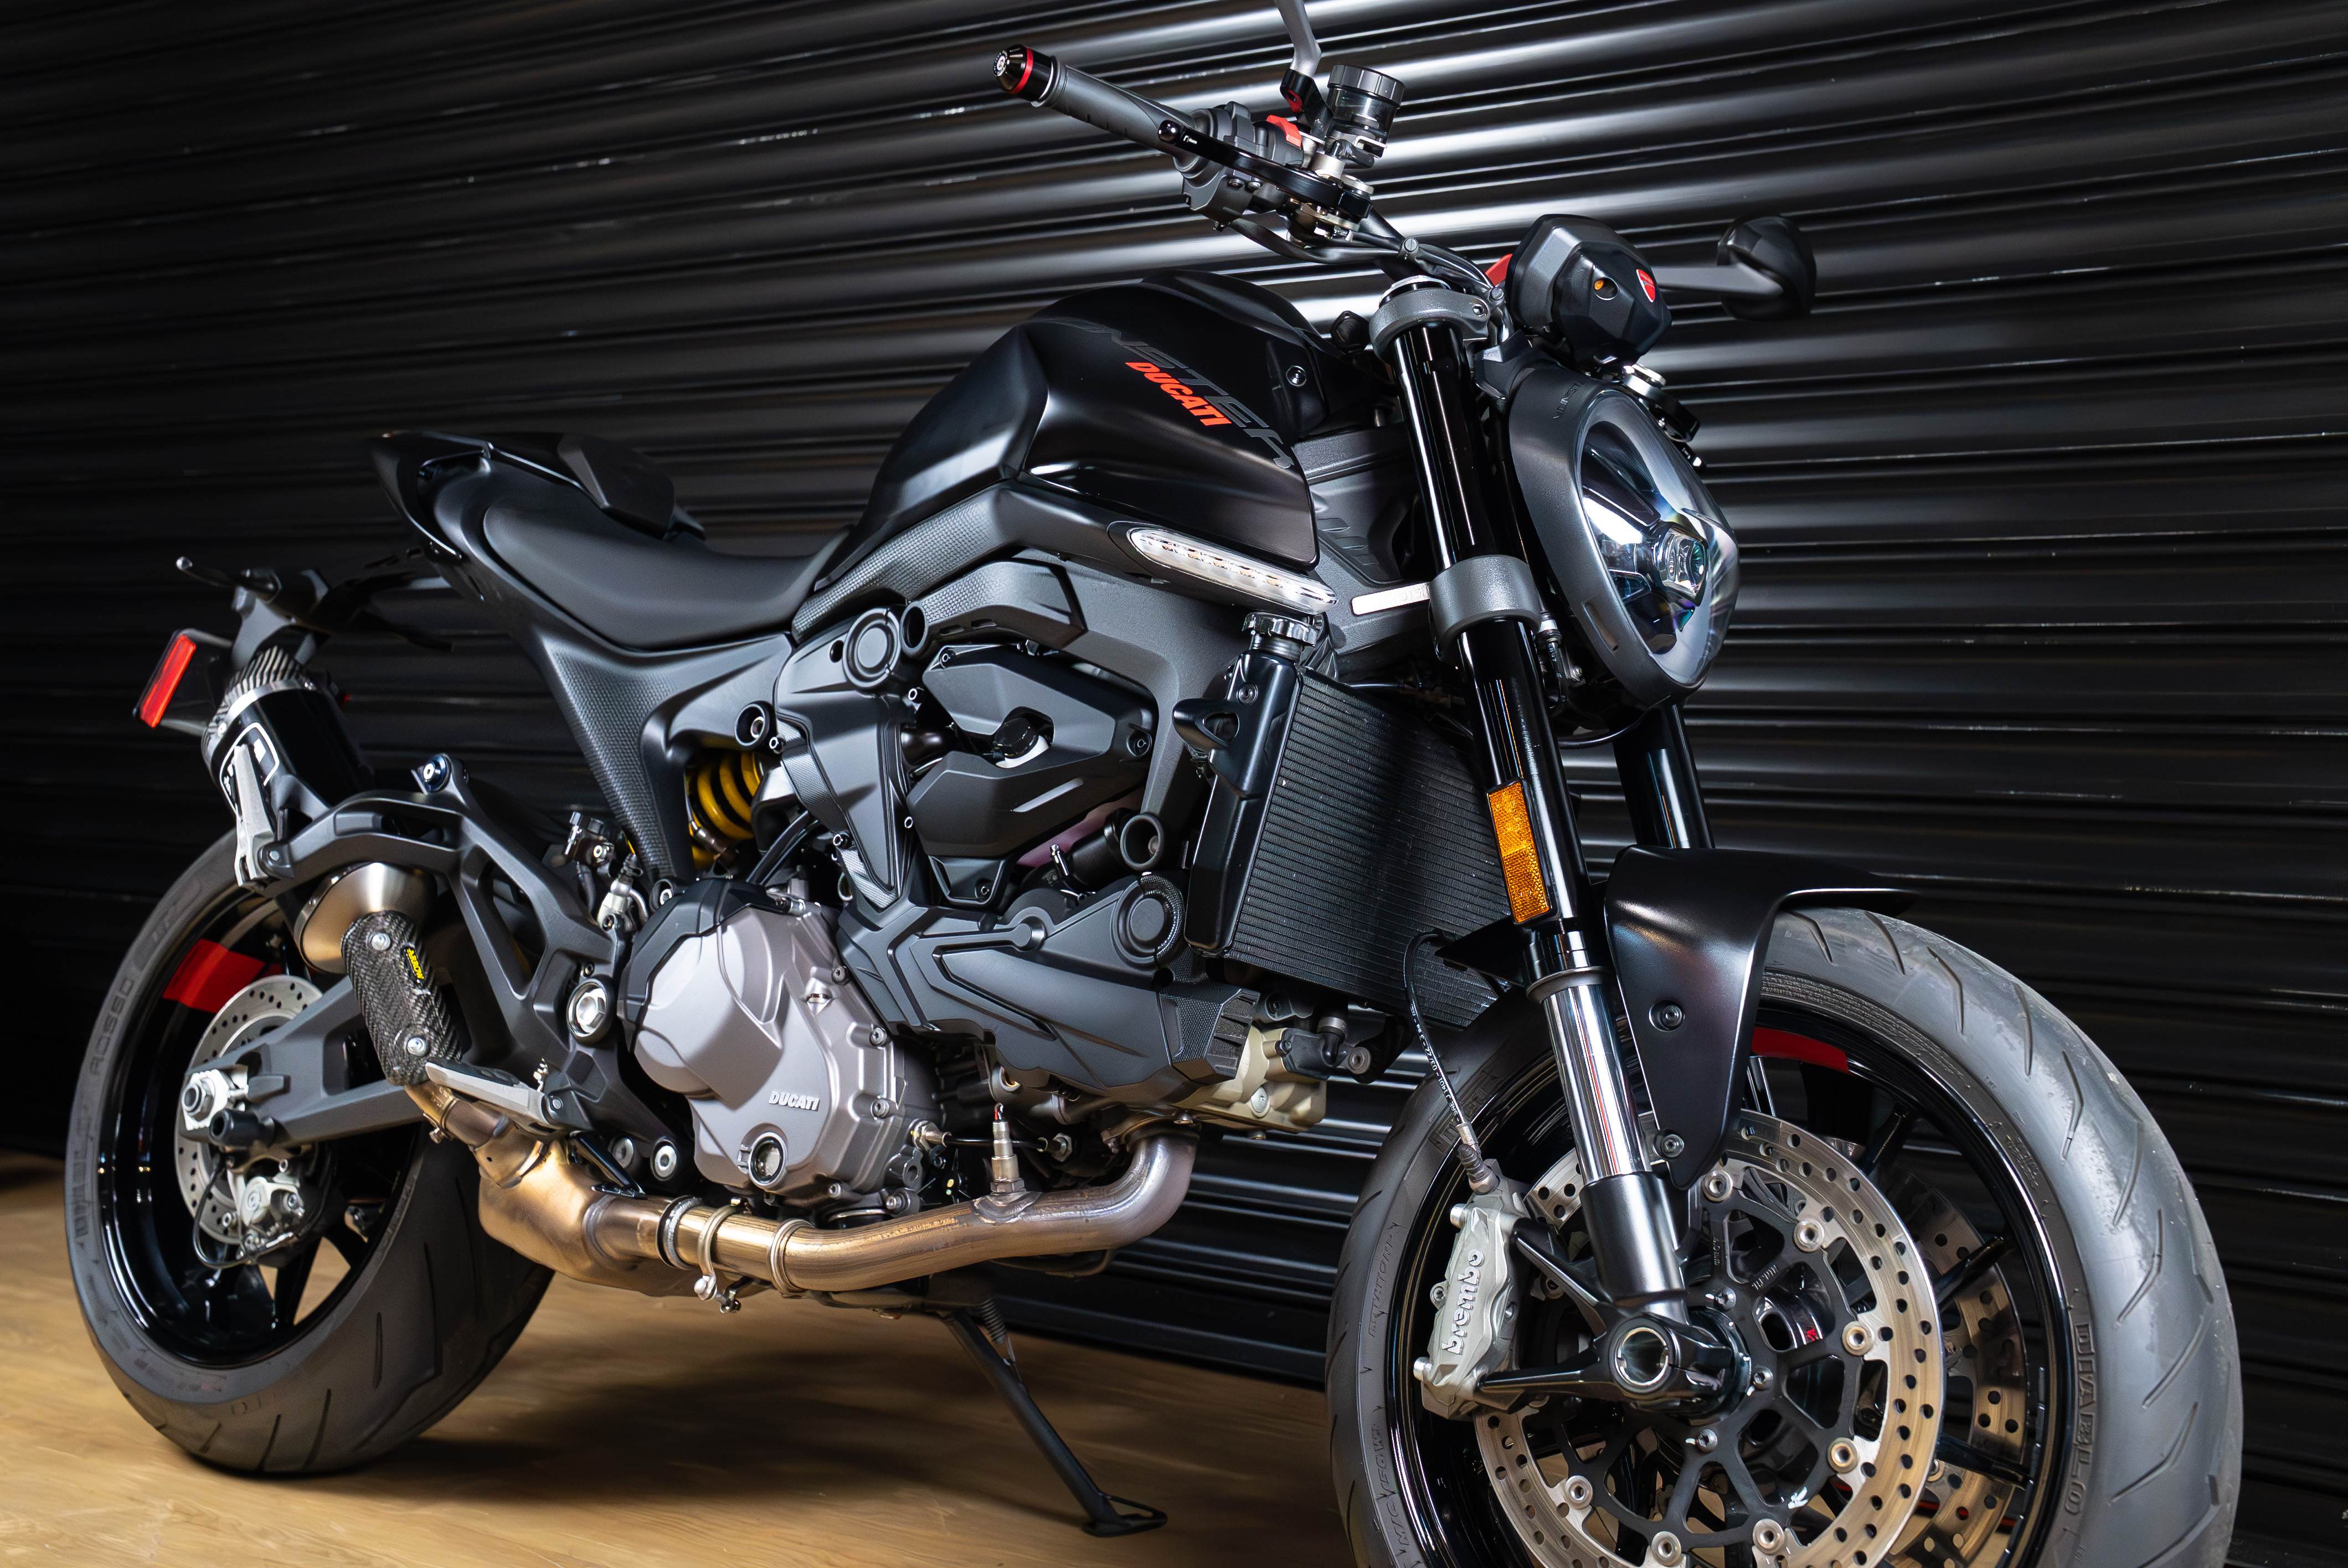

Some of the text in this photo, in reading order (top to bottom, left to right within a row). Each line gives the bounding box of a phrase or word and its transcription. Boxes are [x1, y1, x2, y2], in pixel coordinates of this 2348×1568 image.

[1125, 362, 1232, 426] DUCATI
[1424, 1046, 1438, 1071] 03/22
[768, 1090, 820, 1111] DUCATI
[1448, 1101, 1458, 1116] SAE
[1442, 1249, 1485, 1355] brembo
